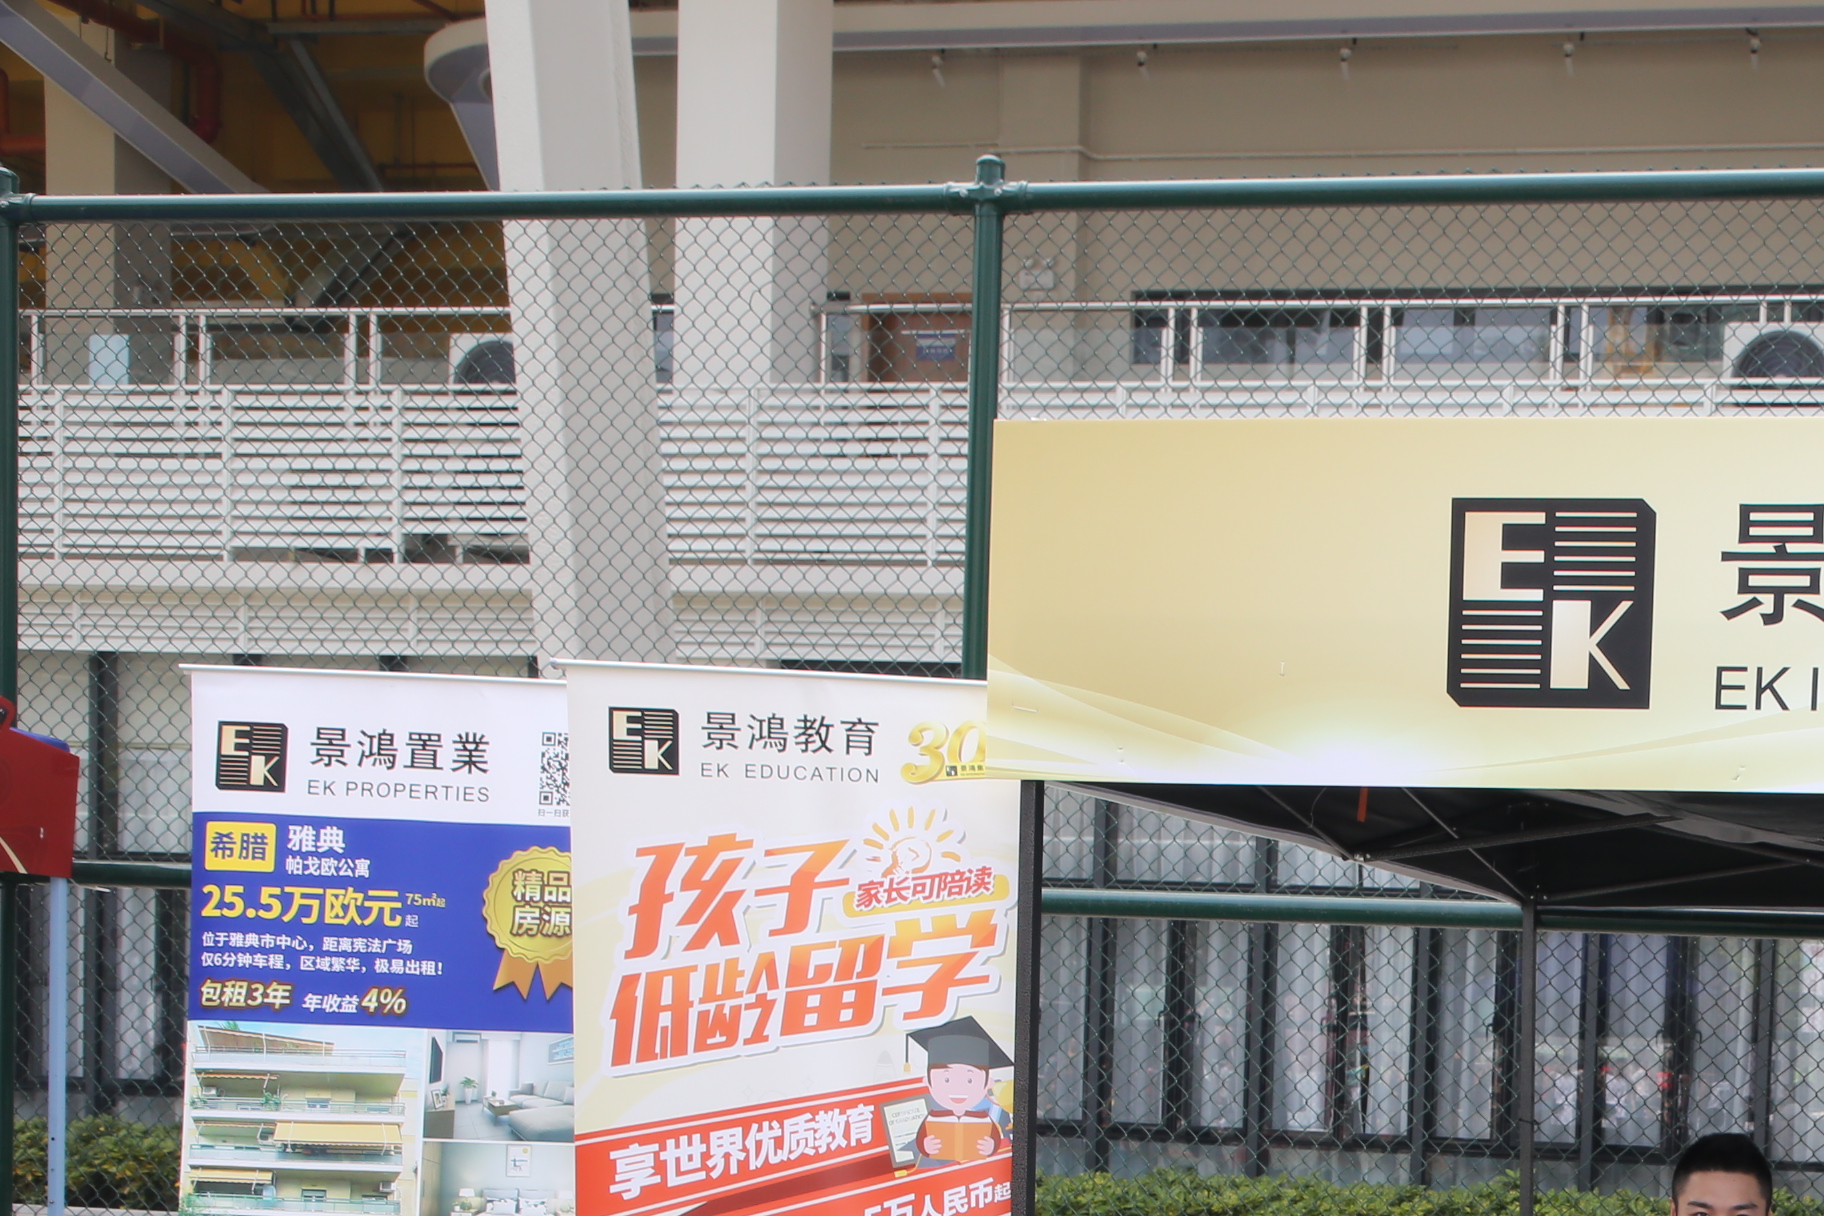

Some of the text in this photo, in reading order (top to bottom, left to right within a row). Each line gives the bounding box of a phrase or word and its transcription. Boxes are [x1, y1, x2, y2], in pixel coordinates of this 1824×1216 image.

[1714, 665, 1792, 711] EK
[309, 725, 491, 775] 景鴻置業
[701, 712, 880, 756] 景鴻教育
[307, 779, 491, 803] EK PROPERTIES
[700, 763, 880, 784] EK EDUCATION
[210, 831, 269, 862] 希腊
[287, 825, 346, 854] 雅典
[285, 856, 370, 878] 帕戈欧公寓
[512, 869, 572, 903] 精品
[201, 885, 403, 928] 25.5万欧元
[624, 832, 851, 960] 孩子
[856, 866, 993, 909] 家长可陪读
[511, 905, 572, 936] 房源
[201, 980, 291, 1009] 包租3年
[609, 908, 998, 1067] 低龄留学
[609, 1104, 875, 1201] 享世界优质教育
